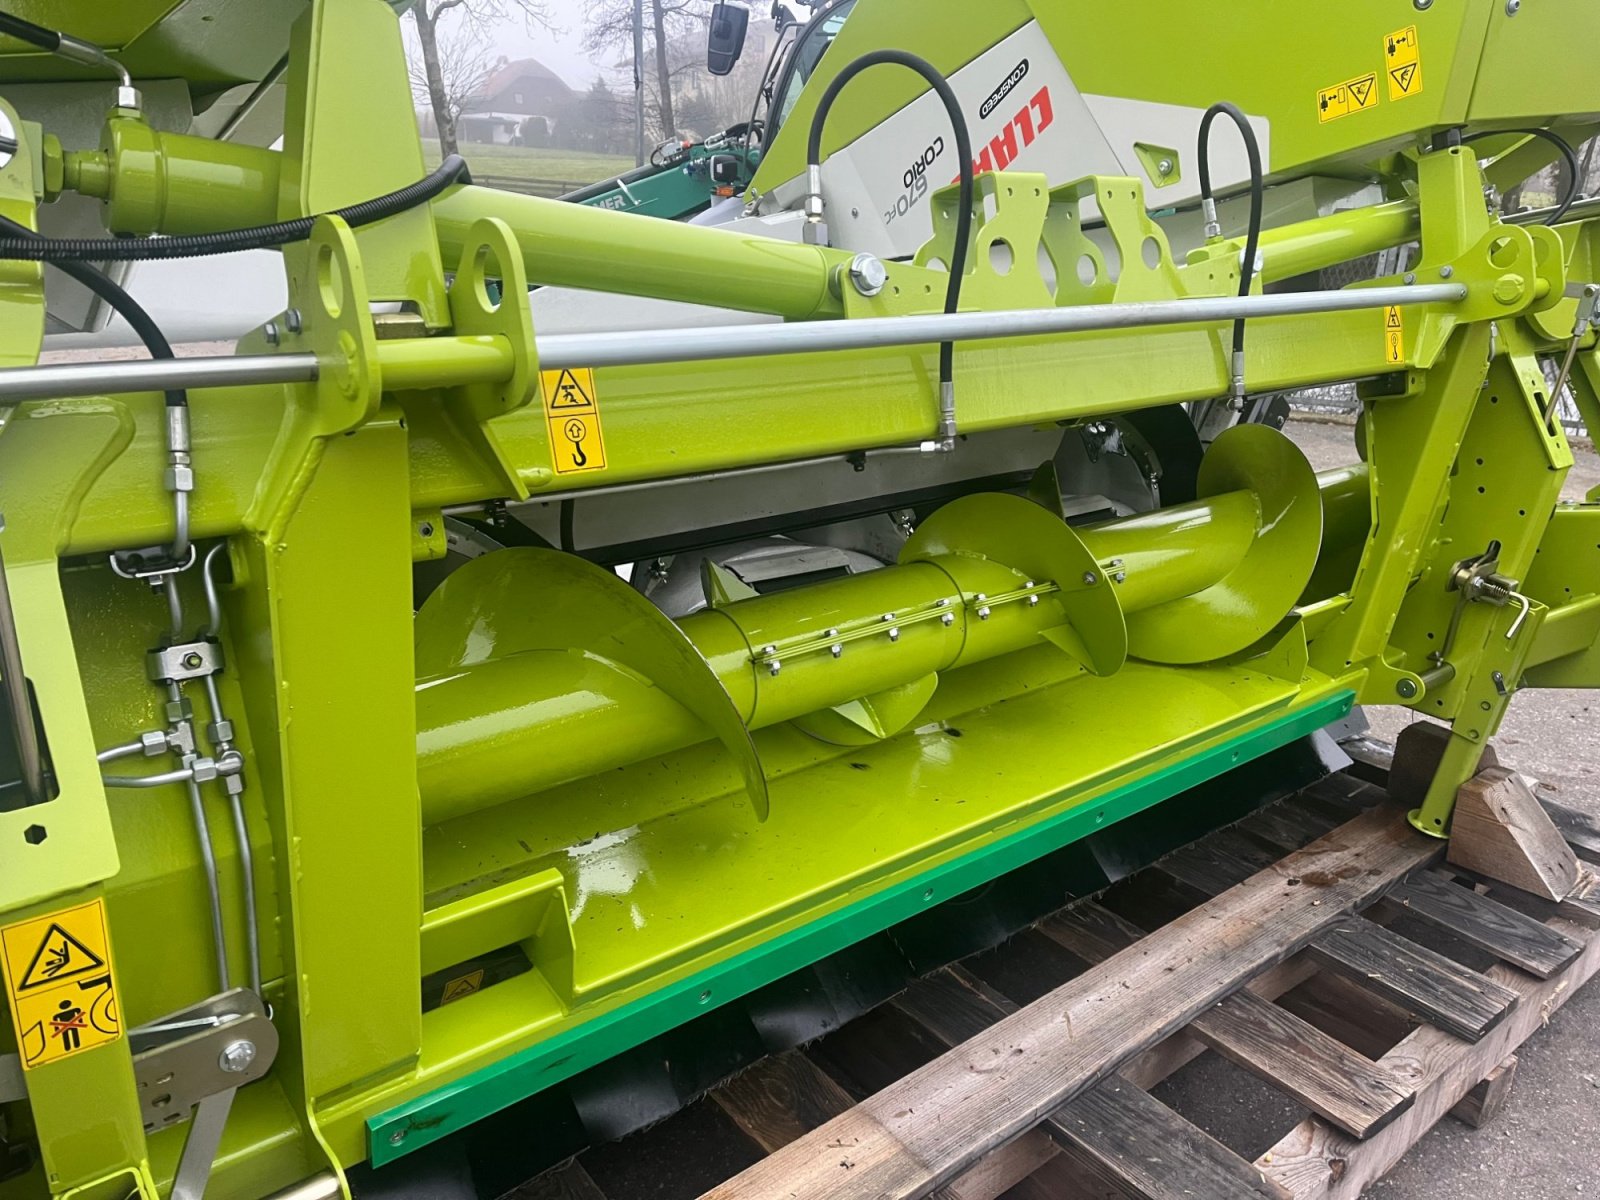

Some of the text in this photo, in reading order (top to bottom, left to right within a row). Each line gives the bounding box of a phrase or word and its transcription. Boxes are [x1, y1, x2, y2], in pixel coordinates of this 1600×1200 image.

[981, 63, 1026, 116] CONSPEED
[903, 136, 944, 188] CORIO
[884, 174, 928, 225] 670FC
